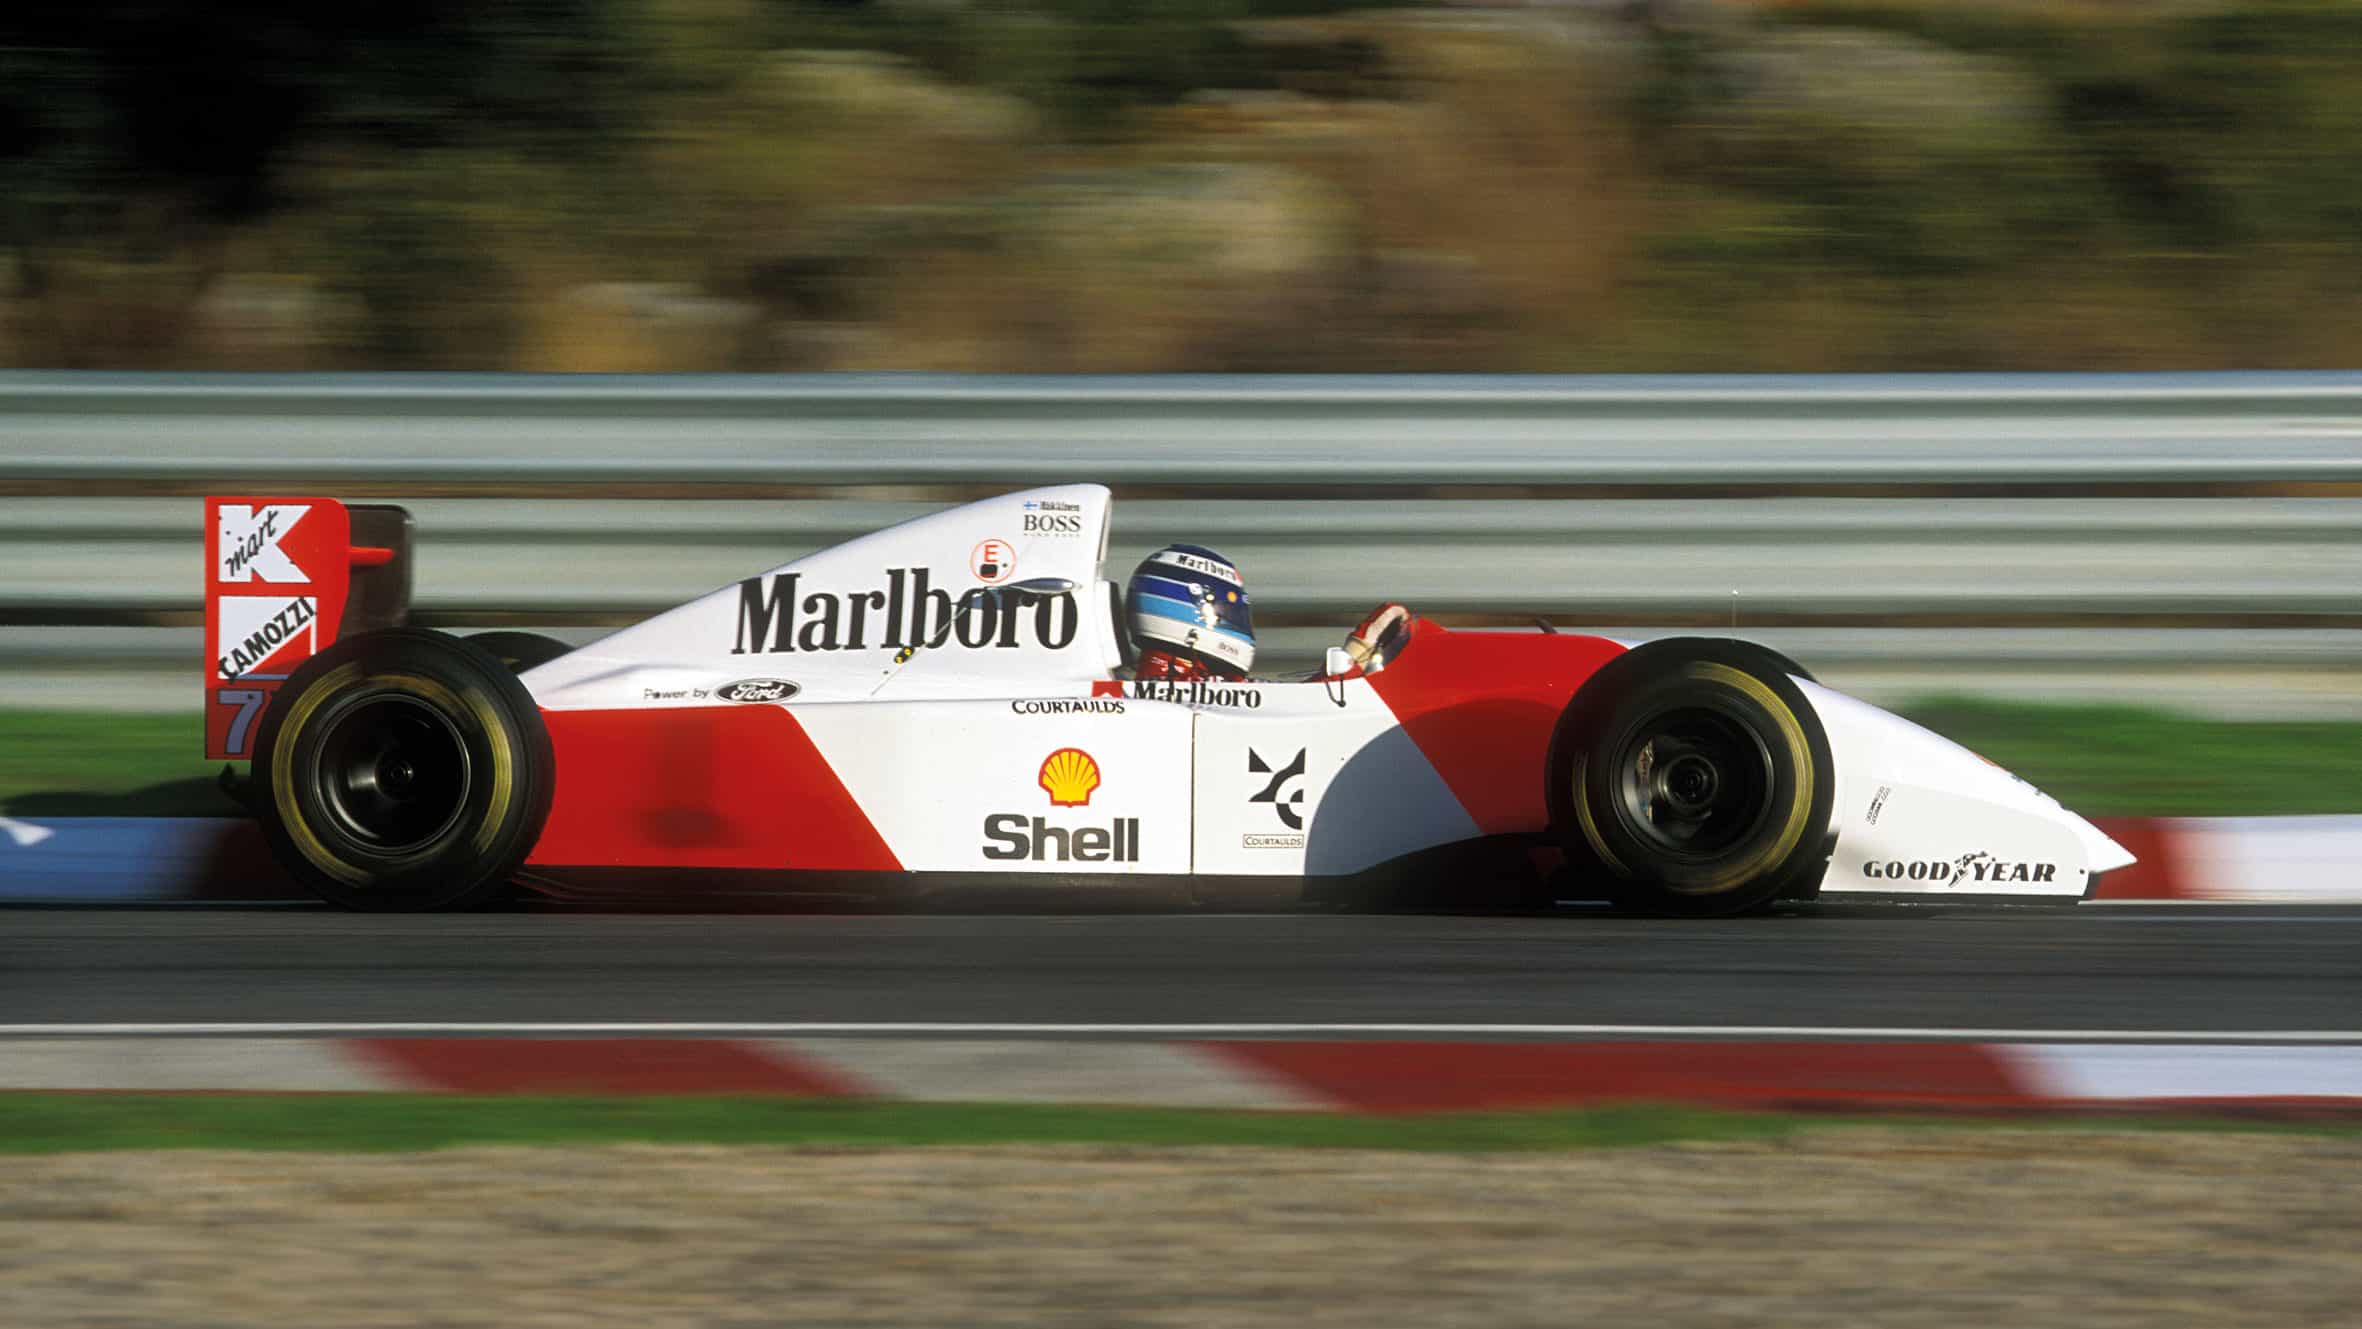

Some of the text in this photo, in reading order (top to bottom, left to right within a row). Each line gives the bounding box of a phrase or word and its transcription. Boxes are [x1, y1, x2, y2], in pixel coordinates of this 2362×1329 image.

[1023, 514, 1081, 532] BOSS
[218, 505, 312, 583] K
[225, 511, 278, 577] mart
[983, 544, 999, 562] E
[1176, 554, 1237, 582] Marlboro
[730, 567, 1078, 655] Marlboro
[218, 596, 318, 684] CAMOZZI
[643, 681, 785, 700] Power by Ford
[1012, 699, 1126, 715] COURTAULDS
[1134, 681, 1262, 708] Marlboro
[217, 688, 266, 755] 7
[982, 813, 1140, 863] Shell
